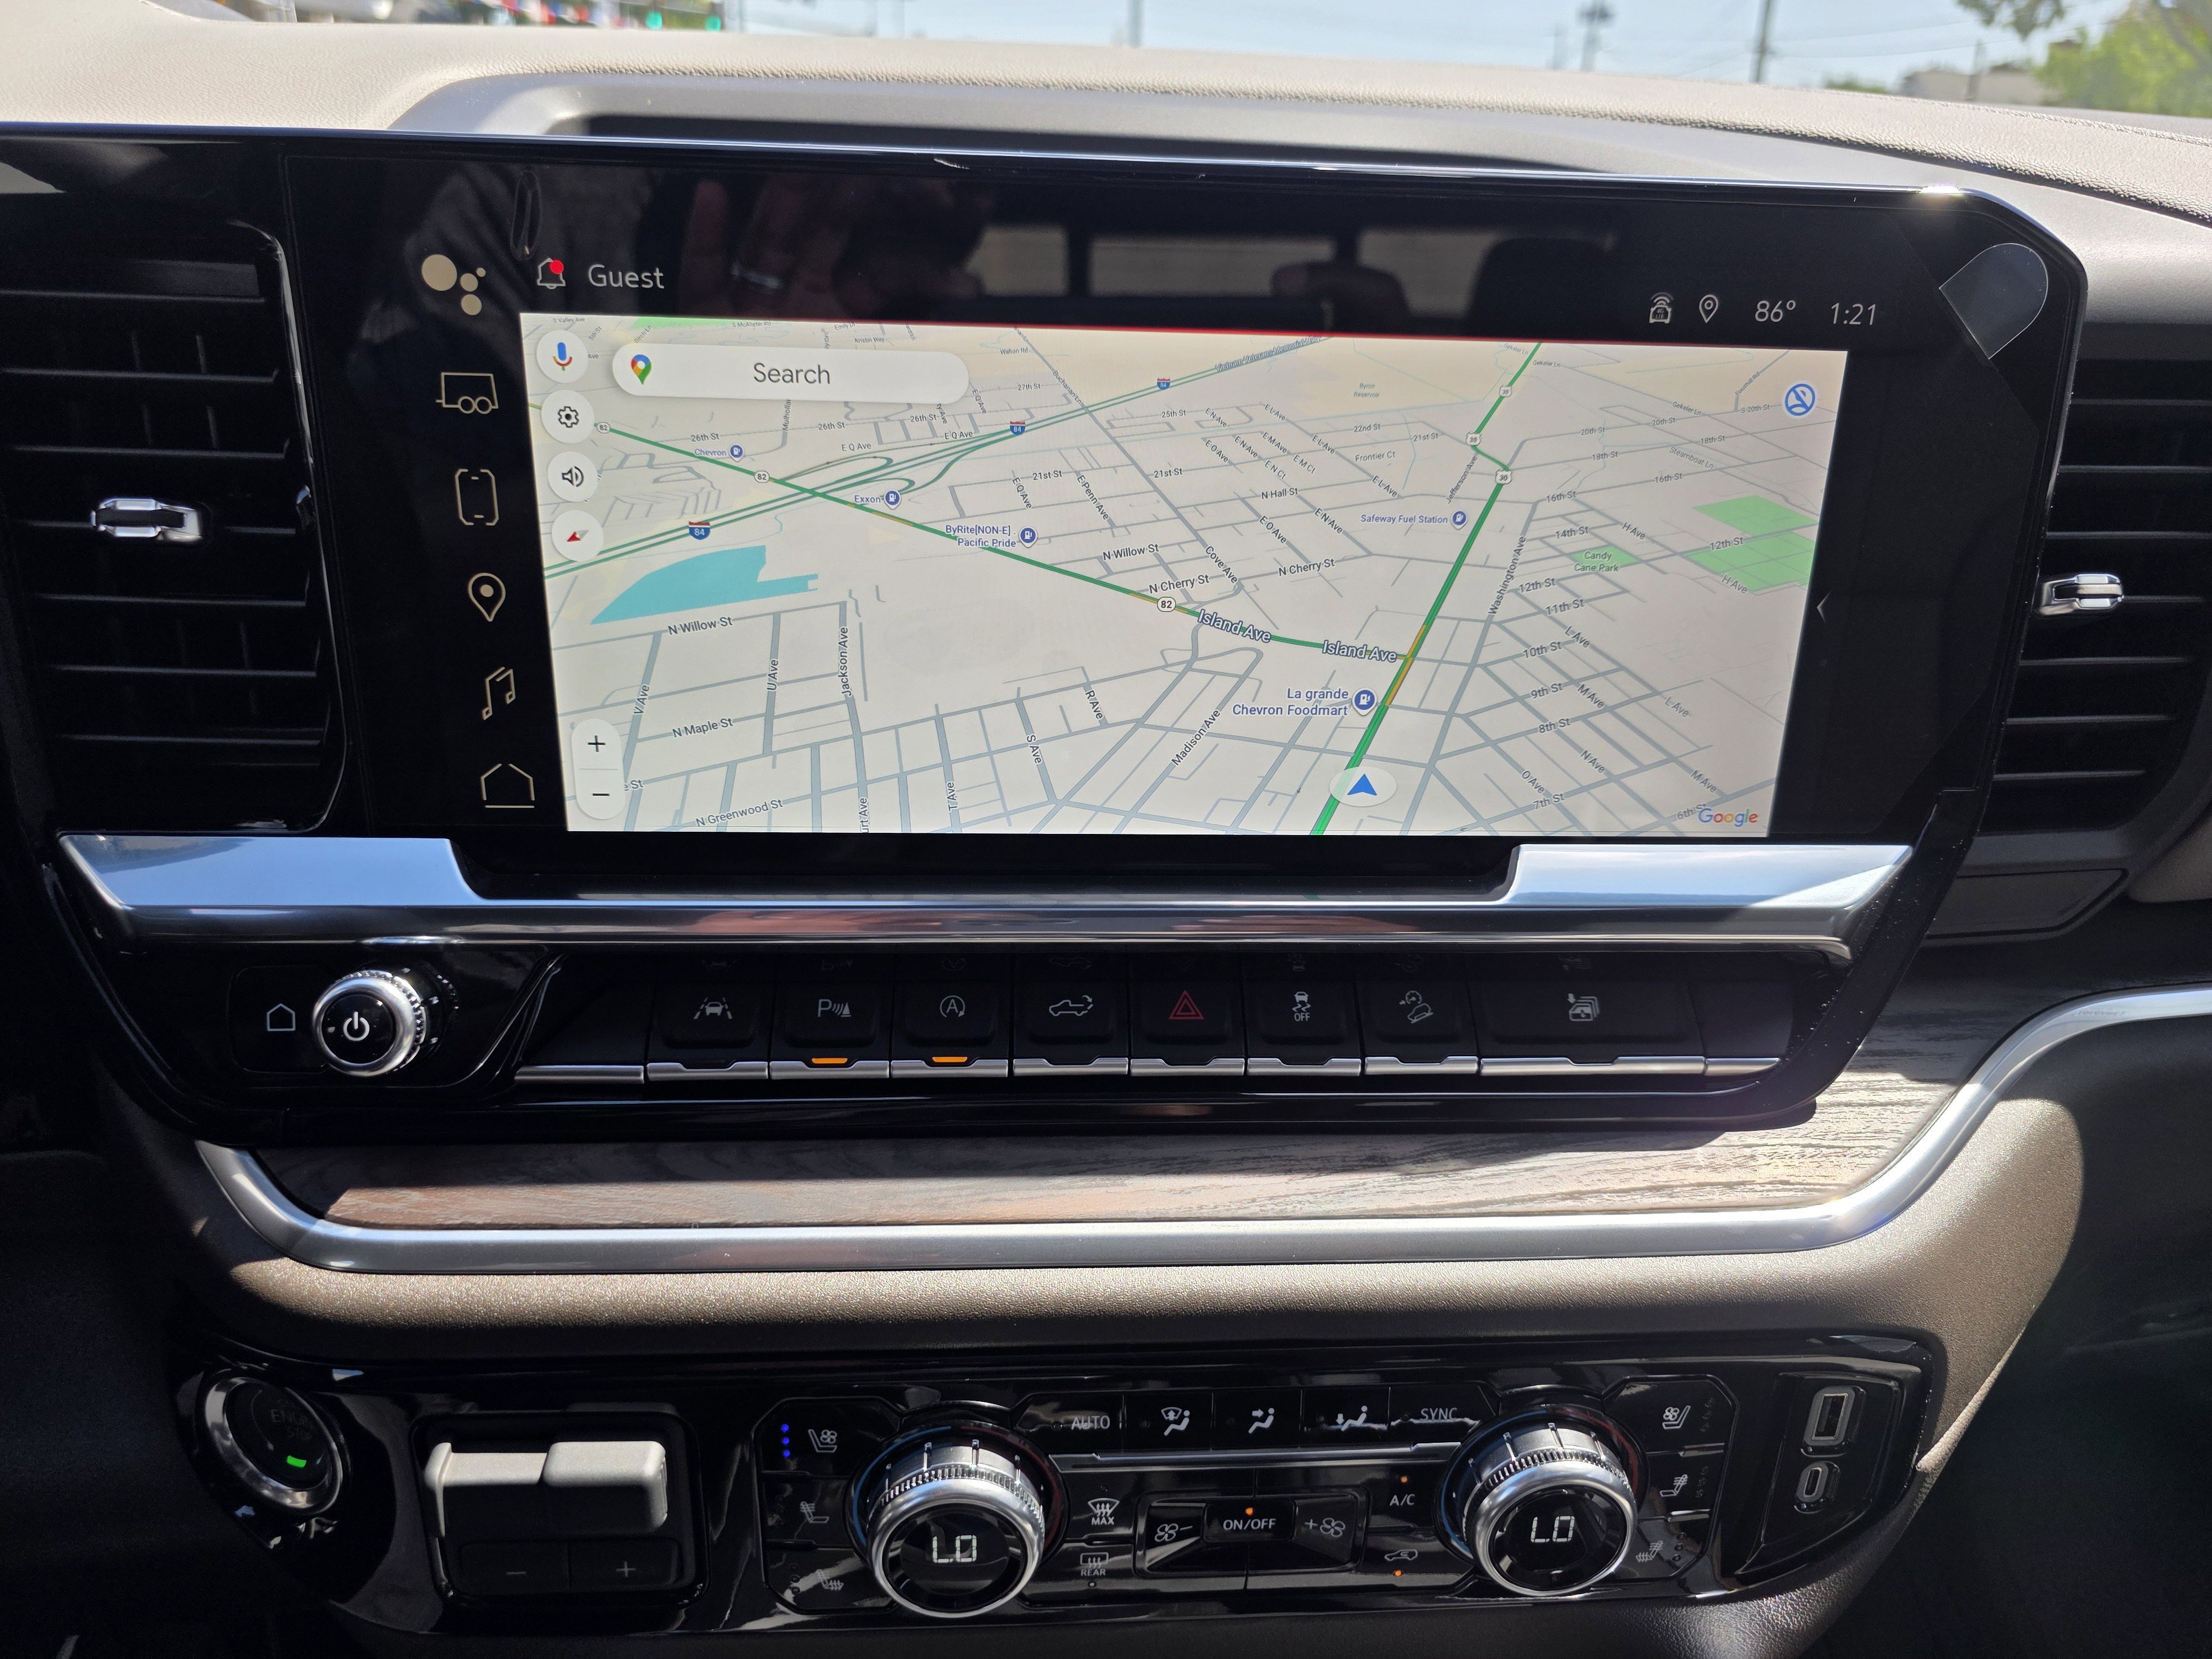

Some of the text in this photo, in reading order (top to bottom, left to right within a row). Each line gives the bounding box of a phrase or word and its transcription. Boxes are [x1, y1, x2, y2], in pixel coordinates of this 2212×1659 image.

[588, 264, 664, 289] Guest
[1831, 303, 1876, 325] 1:21
[754, 363, 830, 384] Search
[1053, 370, 1076, 398] Buchanan
[691, 434, 709, 442] 26th
[695, 448, 727, 457] Chevron
[1274, 442, 1287, 453] Ave
[1355, 451, 1395, 462] Frontier Ct
[1670, 446, 1714, 469] Steamboat Ln
[1033, 472, 1051, 481] 21st
[1154, 468, 1182, 478] 21st St
[1446, 455, 1478, 504] Jefferson Ave
[1655, 474, 1672, 483] 16th
[1082, 482, 1098, 505] Penn
[1096, 502, 1109, 520] Ave
[1271, 488, 1287, 498] Hall
[1289, 488, 1298, 496] St
[1546, 493, 1565, 503] 16th
[1361, 515, 1448, 524] Safeway Fuel Station
[1555, 526, 1589, 539] 14th St
[958, 538, 1016, 547] Pacific Pride
[1709, 537, 1744, 551] 12th St
[1103, 544, 1159, 560] N Willow St
[1584, 552, 1612, 560] Candy
[1206, 546, 1238, 583] Cove Ave
[1279, 559, 1335, 576] N Cherry St
[1599, 564, 1619, 572] Park
[1488, 536, 1526, 615] Washington Ave
[1149, 575, 1209, 593] N Cherry St
[1519, 578, 1556, 593] 12th St
[1545, 599, 1584, 615] 11th St
[668, 617, 733, 635] N Willow St
[1198, 609, 1271, 643] Island Ave
[1322, 640, 1397, 663] Island Ave
[1523, 641, 1562, 658] 10th St
[838, 627, 852, 696] Jackson Ave
[767, 659, 779, 691] U Ave
[1287, 688, 1349, 701] La grande
[1531, 684, 1562, 698] 9th St
[1577, 684, 1604, 708] M Ave
[634, 685, 649, 714] V Ave
[1085, 690, 1103, 719] R Ave
[1233, 704, 1348, 716] Chevron Foodmart
[672, 718, 733, 737] N Maple St
[1538, 718, 1571, 733] 8th St
[1172, 709, 1220, 766] Madison Ave
[1027, 734, 1042, 764] S Ave
[1580, 750, 1605, 773] N Ave
[630, 780, 644, 789] St
[947, 782, 958, 801] Ave
[1532, 793, 1564, 810] 7th St
[696, 800, 782, 826] N Greenwood St
[1677, 807, 1694, 820] 6th
[1698, 808, 1758, 827] Google
[1294, 1013, 1310, 1022] OFF
[1420, 1407, 1458, 1421] SYNC
[1071, 1415, 1110, 1430] AUTO
[1390, 1494, 1415, 1506] A/C
[1091, 1516, 1115, 1525] MAX
[1223, 1518, 1276, 1531] ON/OFF
